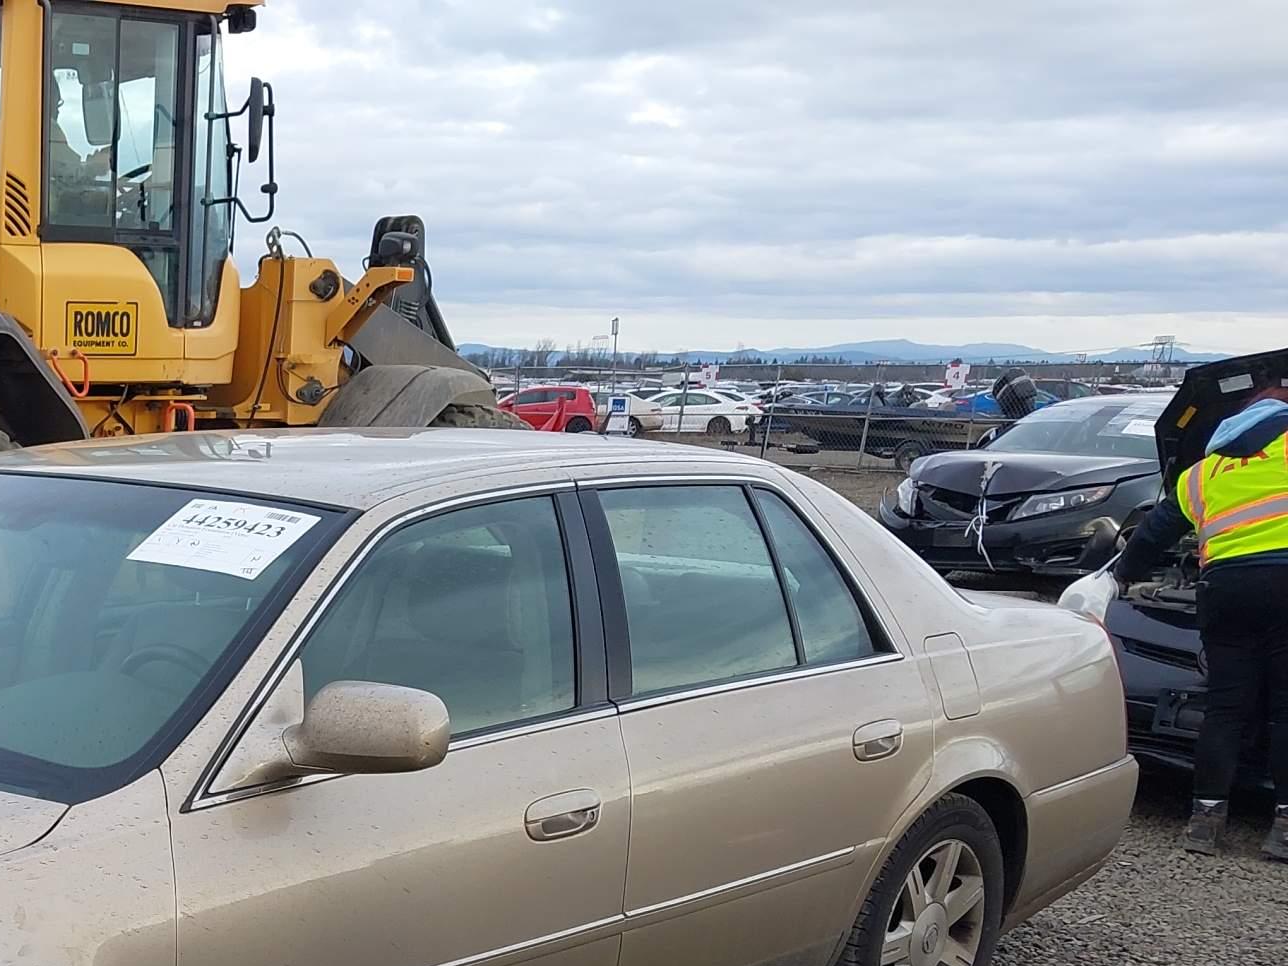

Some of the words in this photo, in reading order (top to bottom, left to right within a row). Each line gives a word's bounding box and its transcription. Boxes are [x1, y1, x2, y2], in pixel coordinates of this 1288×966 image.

[73, 310, 131, 337] ROMCO
[705, 371, 712, 380] 5
[952, 371, 960, 379] 4
[183, 514, 286, 537] 44259423
